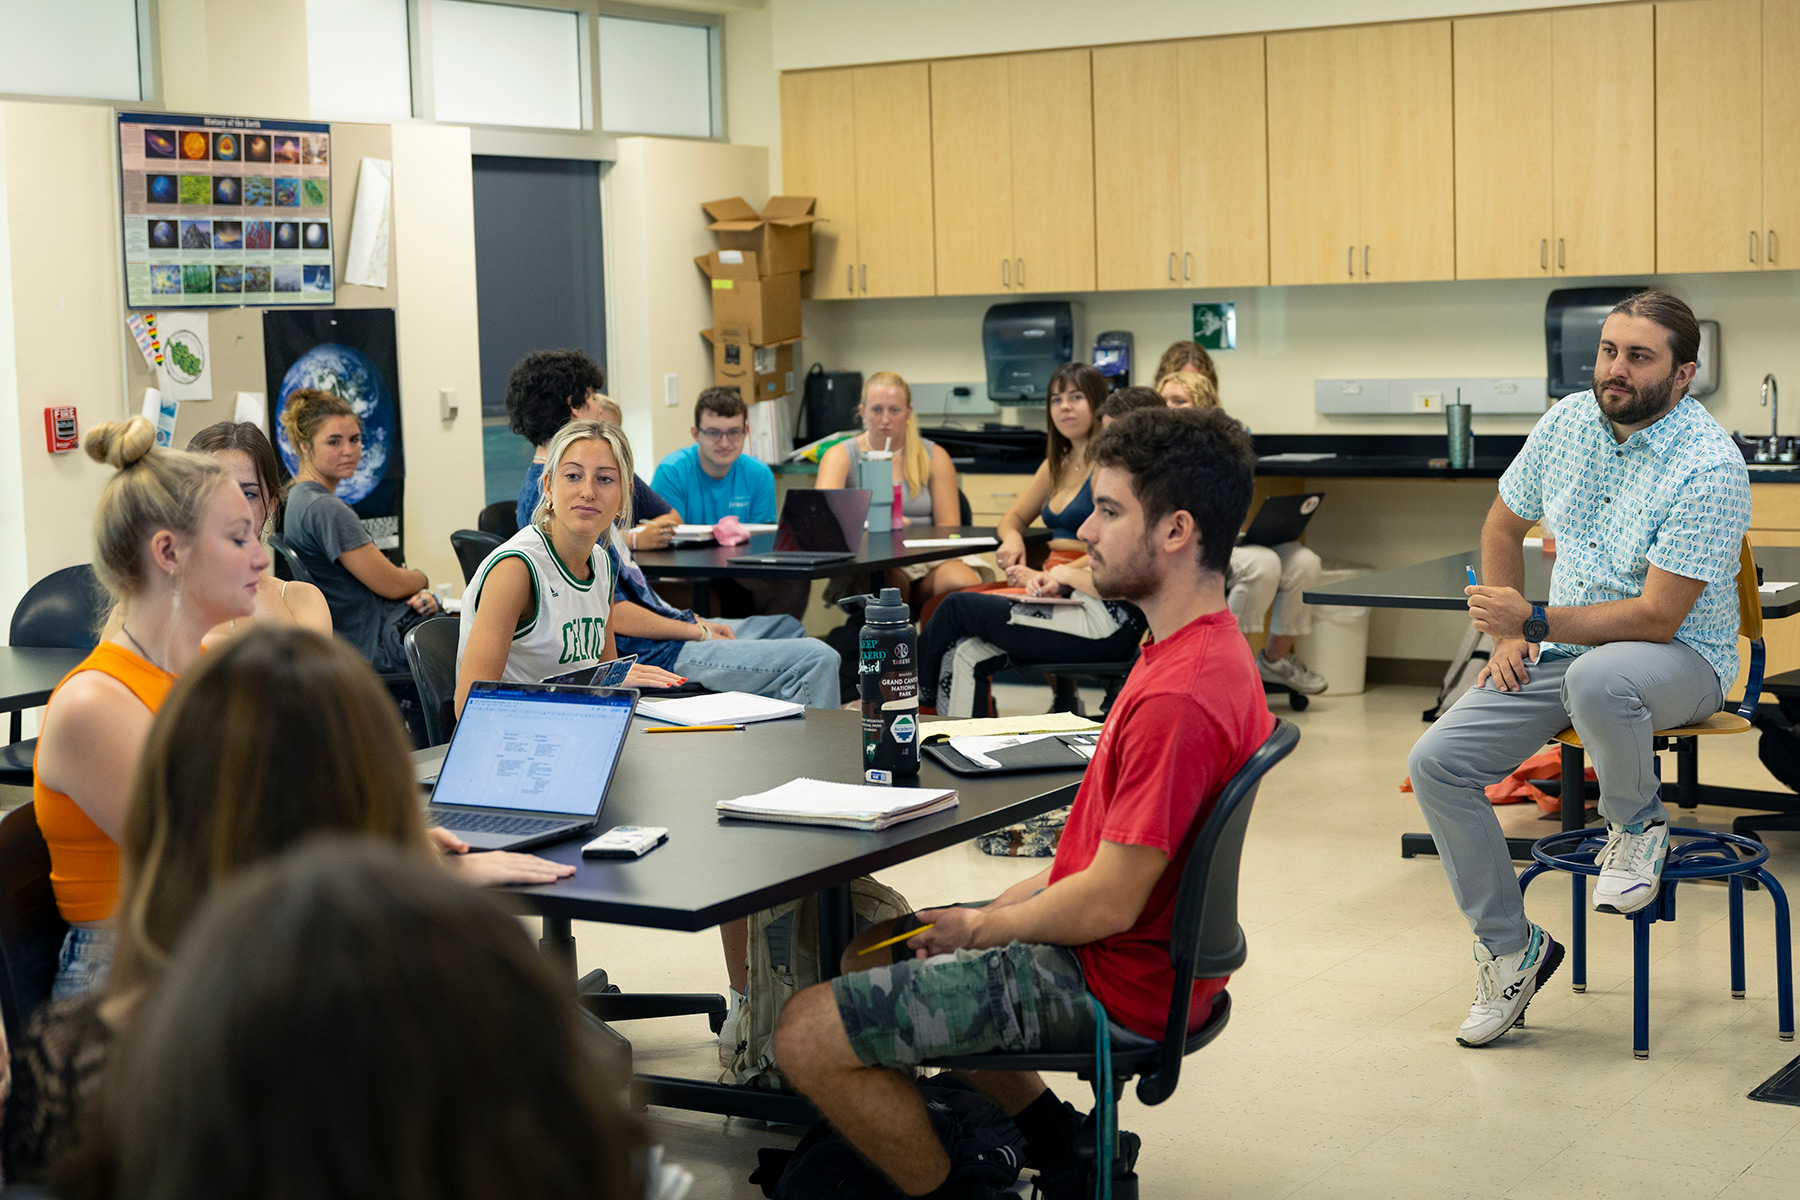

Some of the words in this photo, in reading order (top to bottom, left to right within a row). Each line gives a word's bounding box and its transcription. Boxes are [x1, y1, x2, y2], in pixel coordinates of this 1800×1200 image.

[204, 118, 226, 128] History
[235, 118, 244, 127] the
[245, 120, 261, 128] Earth
[55, 408, 75, 419] FIRE
[559, 617, 606, 664] CELTIC
